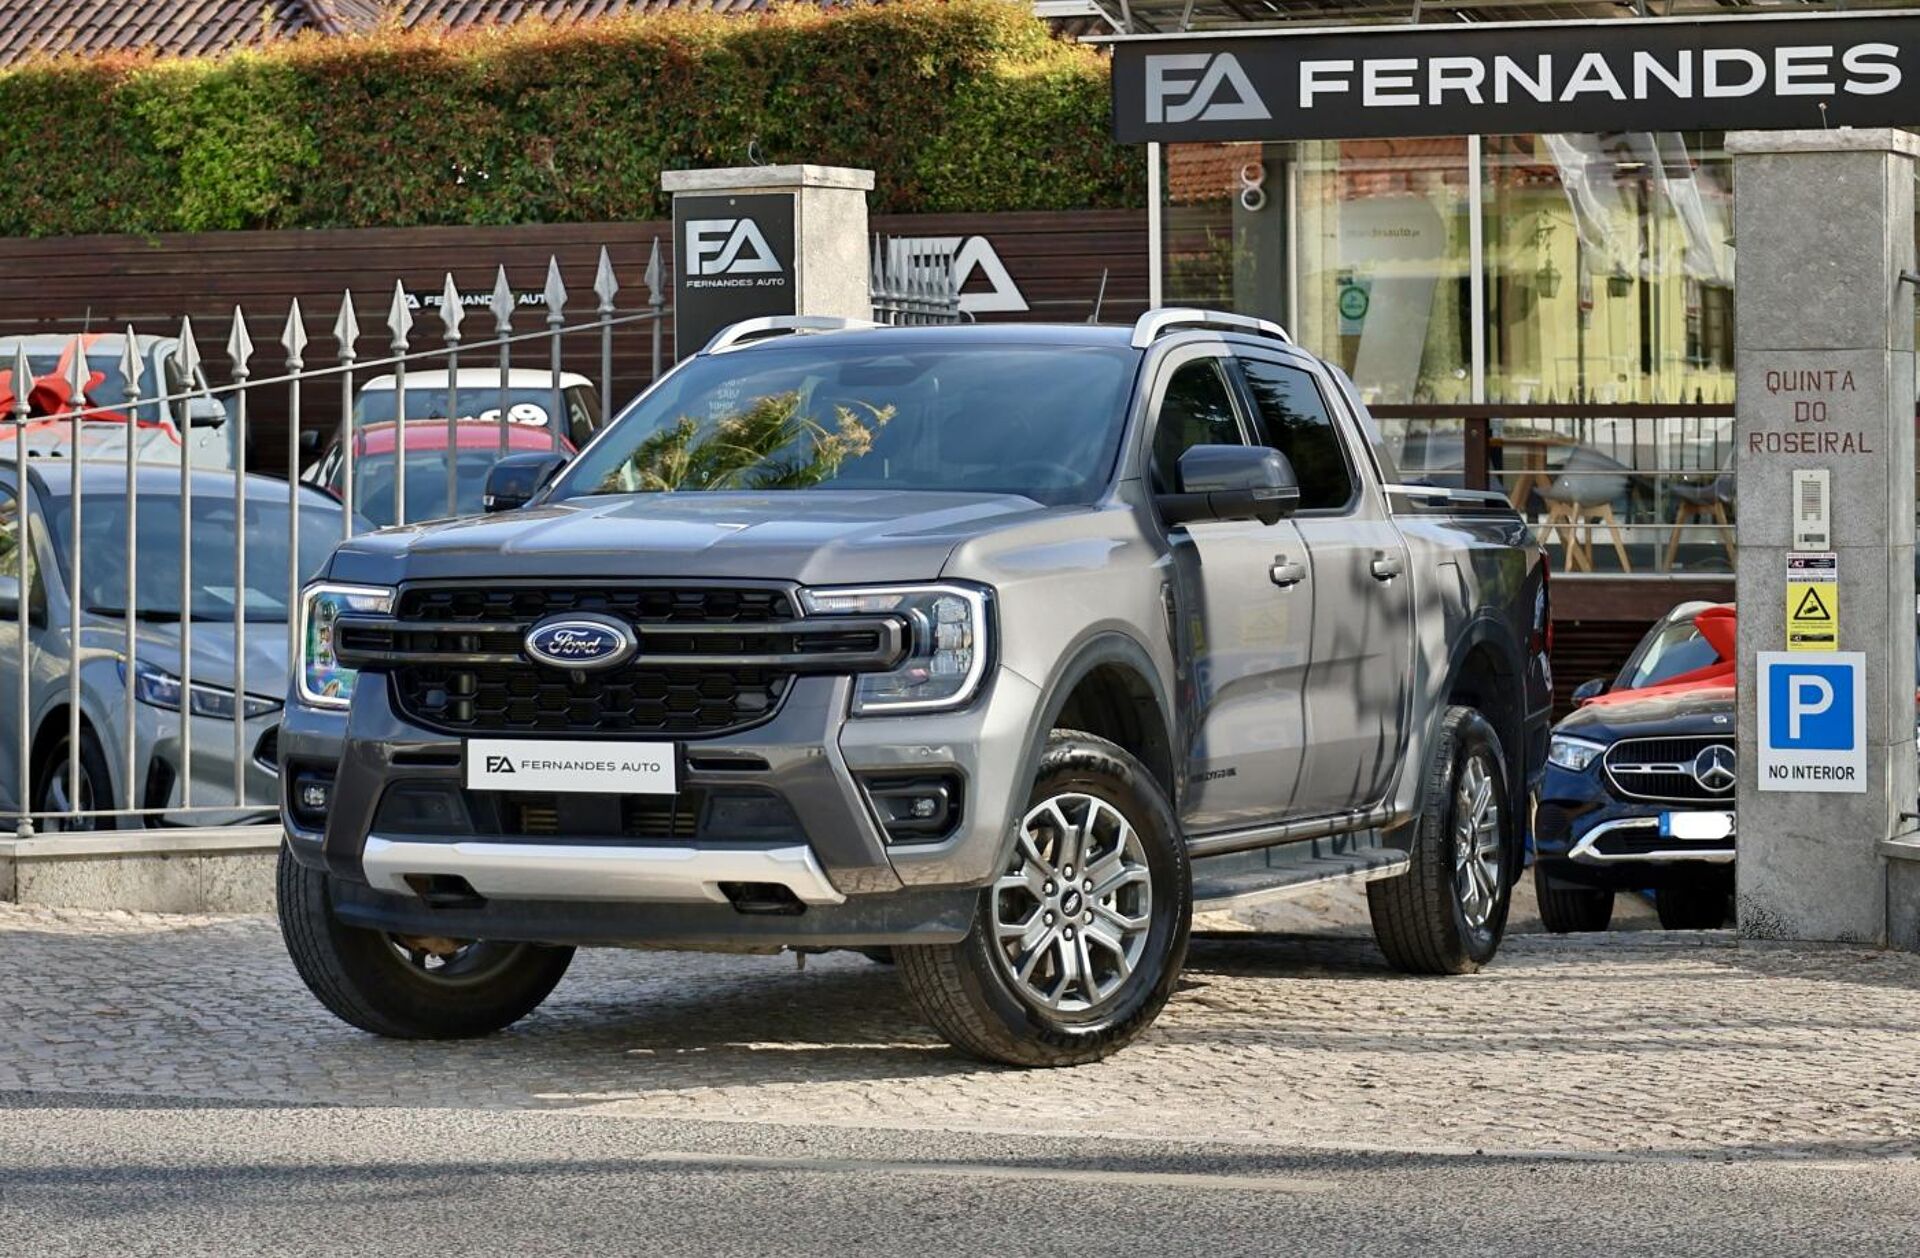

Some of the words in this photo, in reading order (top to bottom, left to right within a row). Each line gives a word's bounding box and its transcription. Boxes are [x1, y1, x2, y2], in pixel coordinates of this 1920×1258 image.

[1145, 52, 1272, 123] FA
[1300, 43, 1901, 108] FERNANDES
[685, 218, 784, 275] FA
[686, 279, 754, 288] FERNANDES
[756, 278, 785, 286] AUTO
[403, 293, 421, 309] A
[519, 294, 548, 304] AUT
[1766, 370, 1856, 395] QUINTA
[1795, 401, 1826, 422] DO
[1749, 432, 1873, 454] ROSEIRAL
[549, 630, 602, 655] Ford
[1789, 674, 1834, 739] P
[486, 756, 516, 773] FA
[521, 760, 616, 771] FERNANDES
[621, 762, 661, 772] AUTO
[1768, 765, 1788, 779] NO
[1792, 765, 1855, 780] INTERIOR
